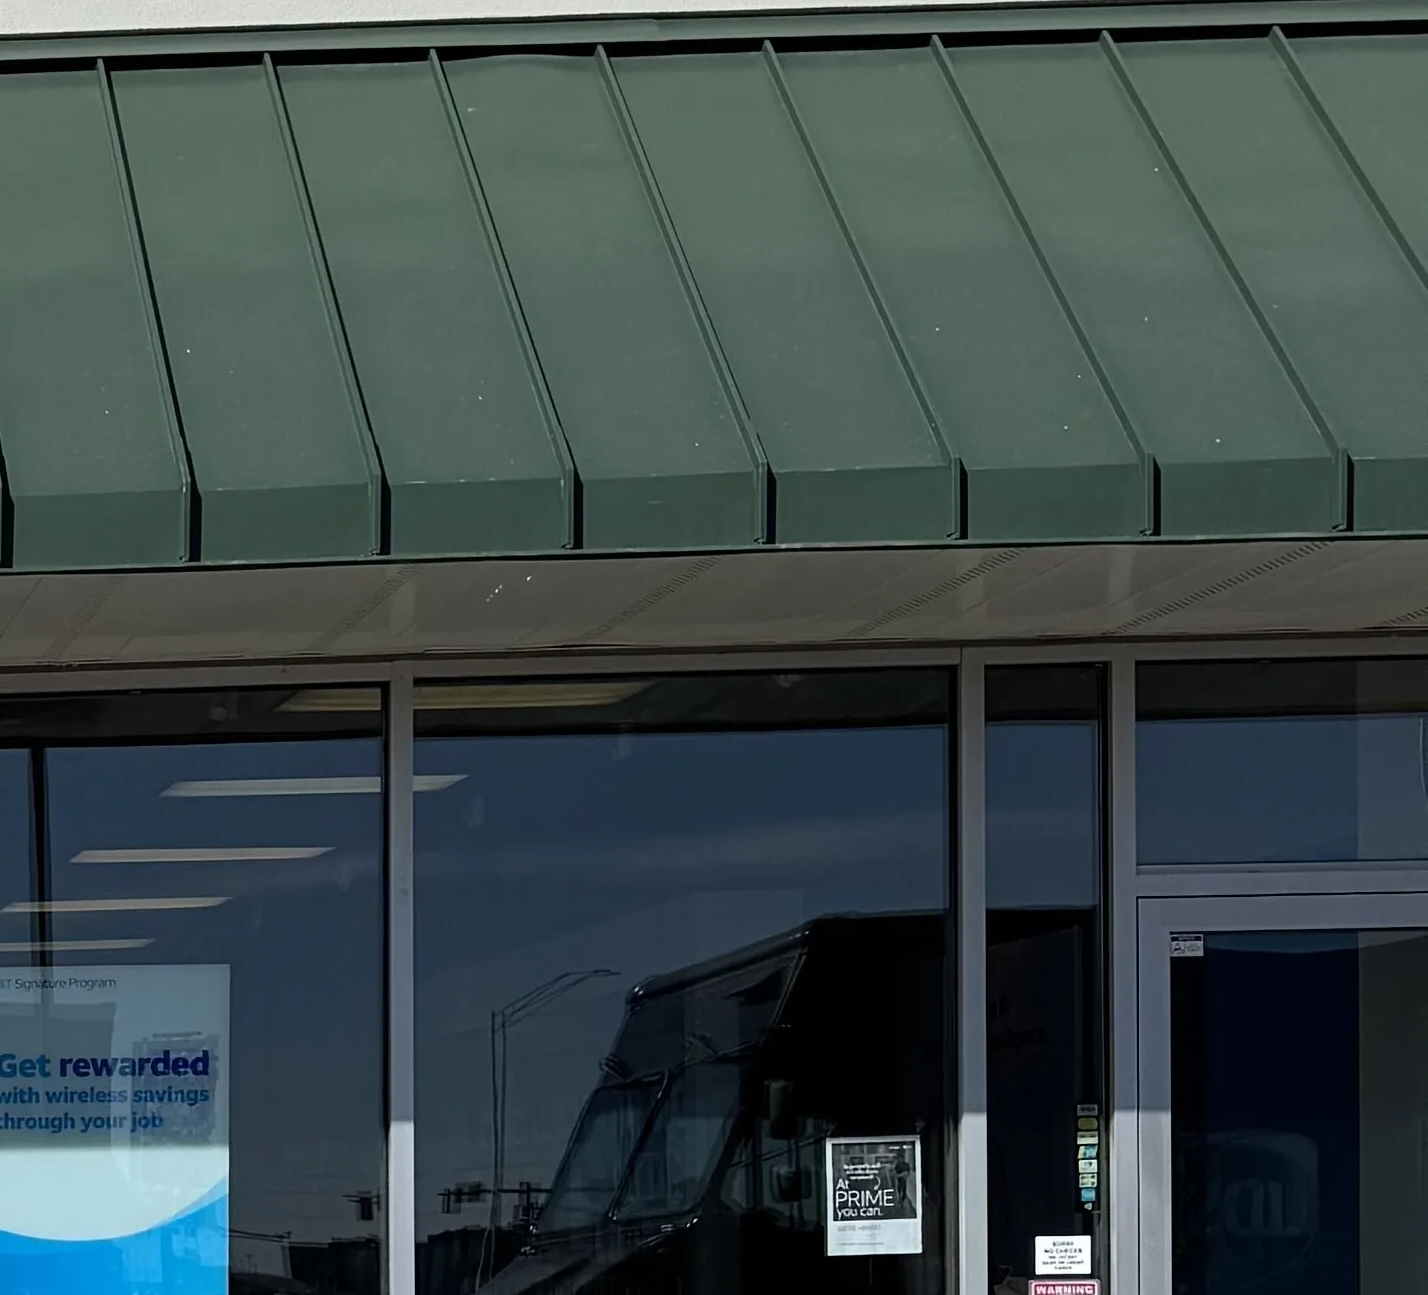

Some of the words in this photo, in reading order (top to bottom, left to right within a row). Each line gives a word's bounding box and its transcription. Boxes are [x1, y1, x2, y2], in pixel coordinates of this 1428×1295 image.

[15, 978, 66, 992] Signature
[69, 977, 117, 991] Program
[59, 1050, 210, 1078] rewarded
[45, 1087, 128, 1104] wireless
[132, 1086, 210, 1107] savings
[80, 1114, 126, 1134] your
[130, 1113, 164, 1133] job
[836, 1178, 850, 1190] At
[835, 1189, 895, 1208] PRIME
[836, 1208, 858, 1220] you
[1035, 1285, 1094, 1295] WARNING
